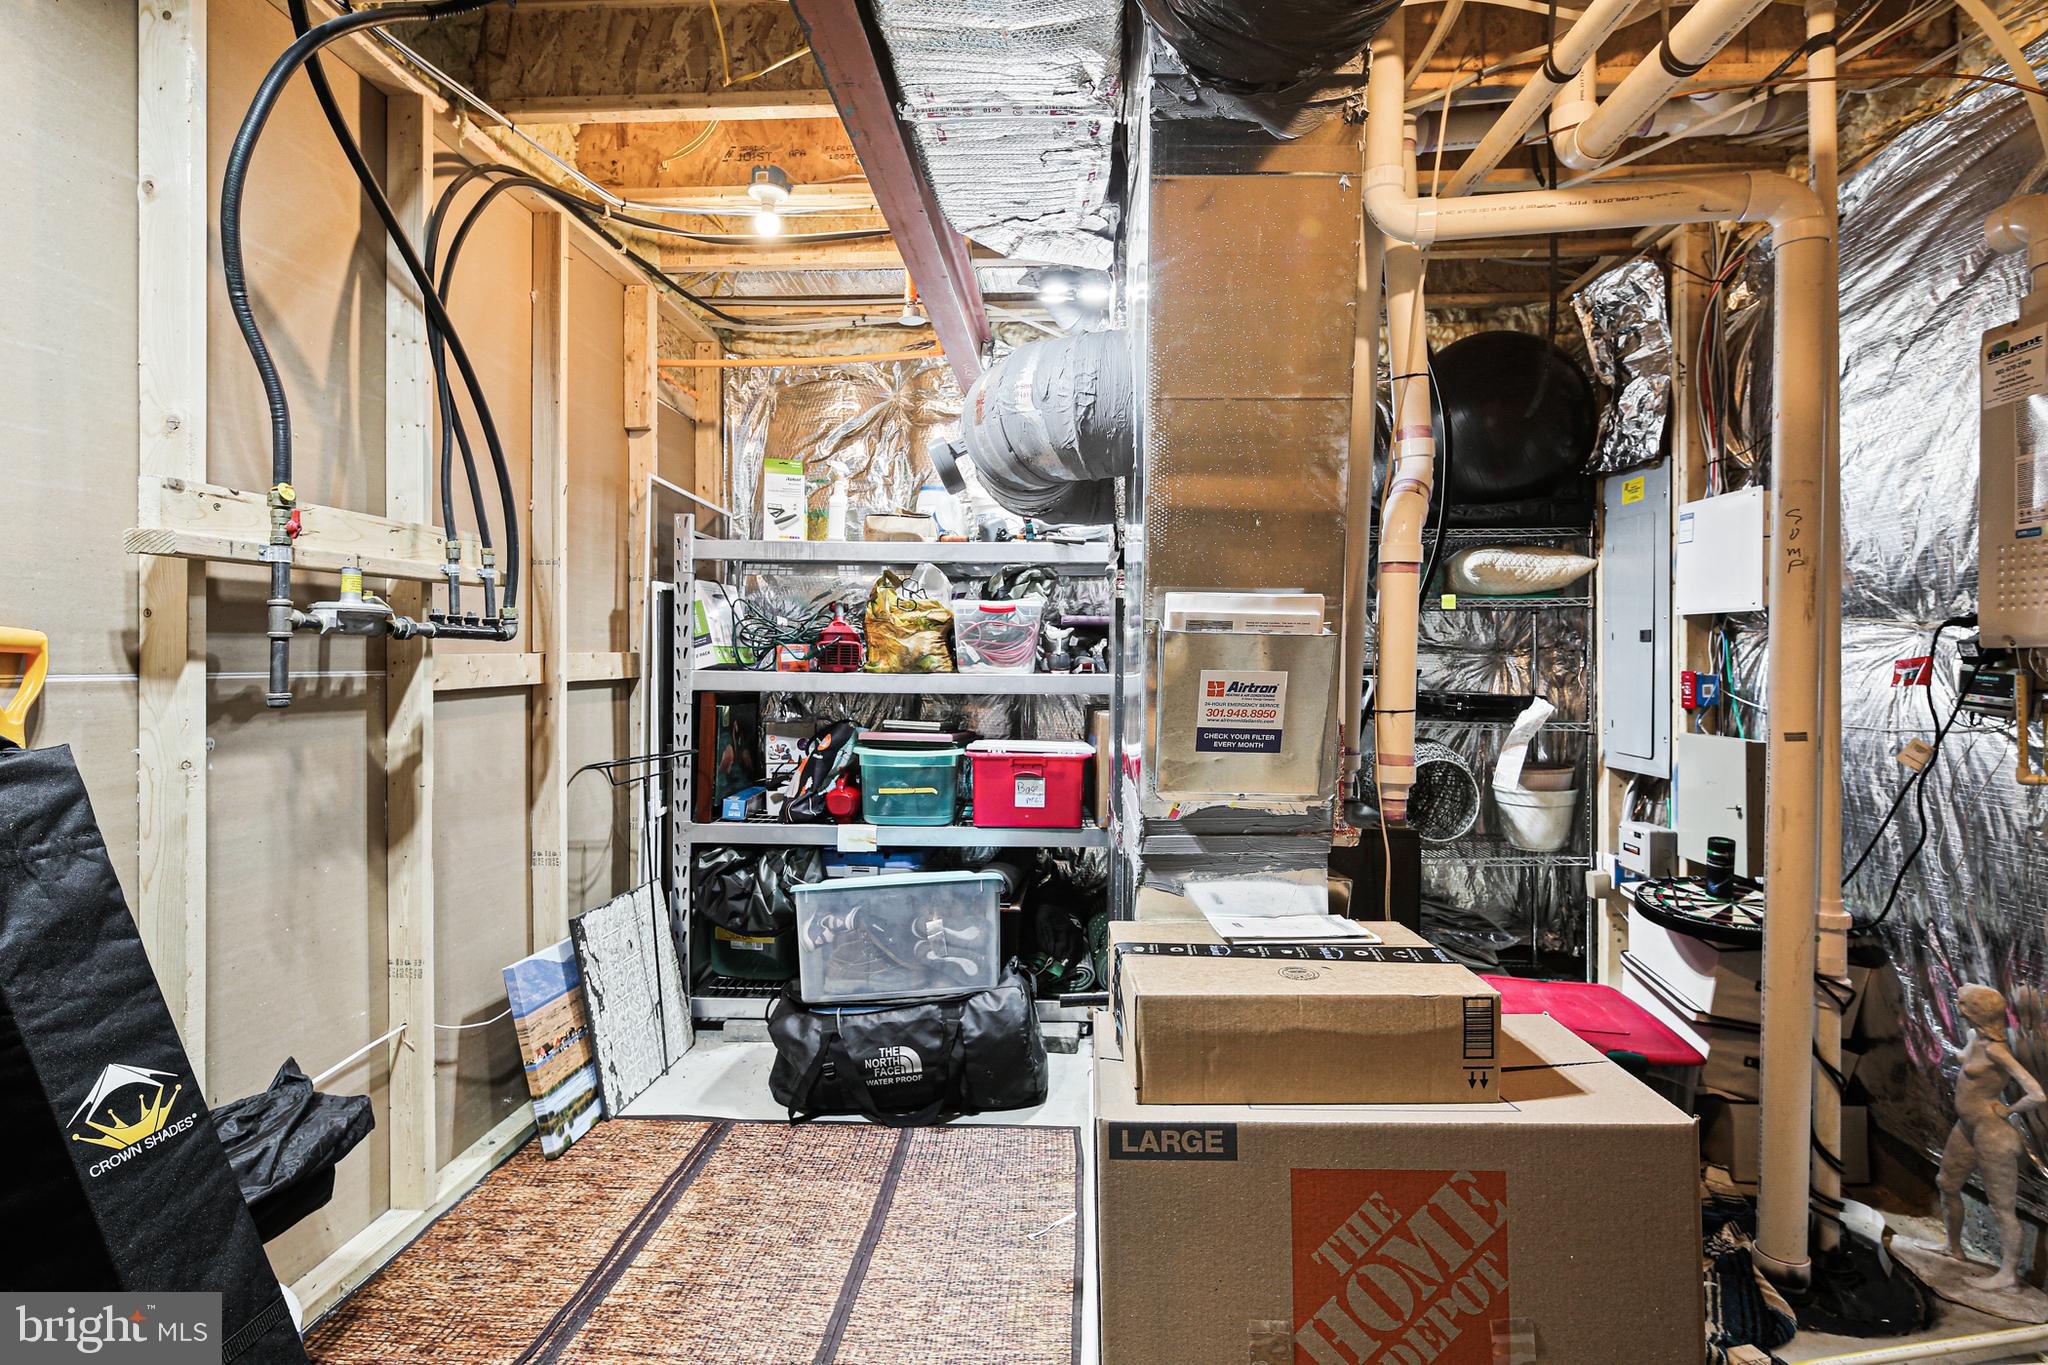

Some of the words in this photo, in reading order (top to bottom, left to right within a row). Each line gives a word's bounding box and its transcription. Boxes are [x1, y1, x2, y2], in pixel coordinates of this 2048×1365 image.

[1226, 681, 1278, 694] Airtron
[1205, 708, 1277, 719] 301.948.8950
[1203, 732, 1229, 740] CHECK
[878, 1046, 900, 1058] THE
[864, 1056, 900, 1069] NORTH
[873, 1065, 901, 1078] FACE
[865, 1077, 895, 1087] WATER
[895, 1074, 923, 1084] PROOF
[89, 1143, 143, 1178] CROWN
[144, 1115, 195, 1150] SHADES
[1121, 1129, 1224, 1153] LARGE
[1310, 1191, 1402, 1276] THE
[1294, 1170, 1508, 1365] HOME
